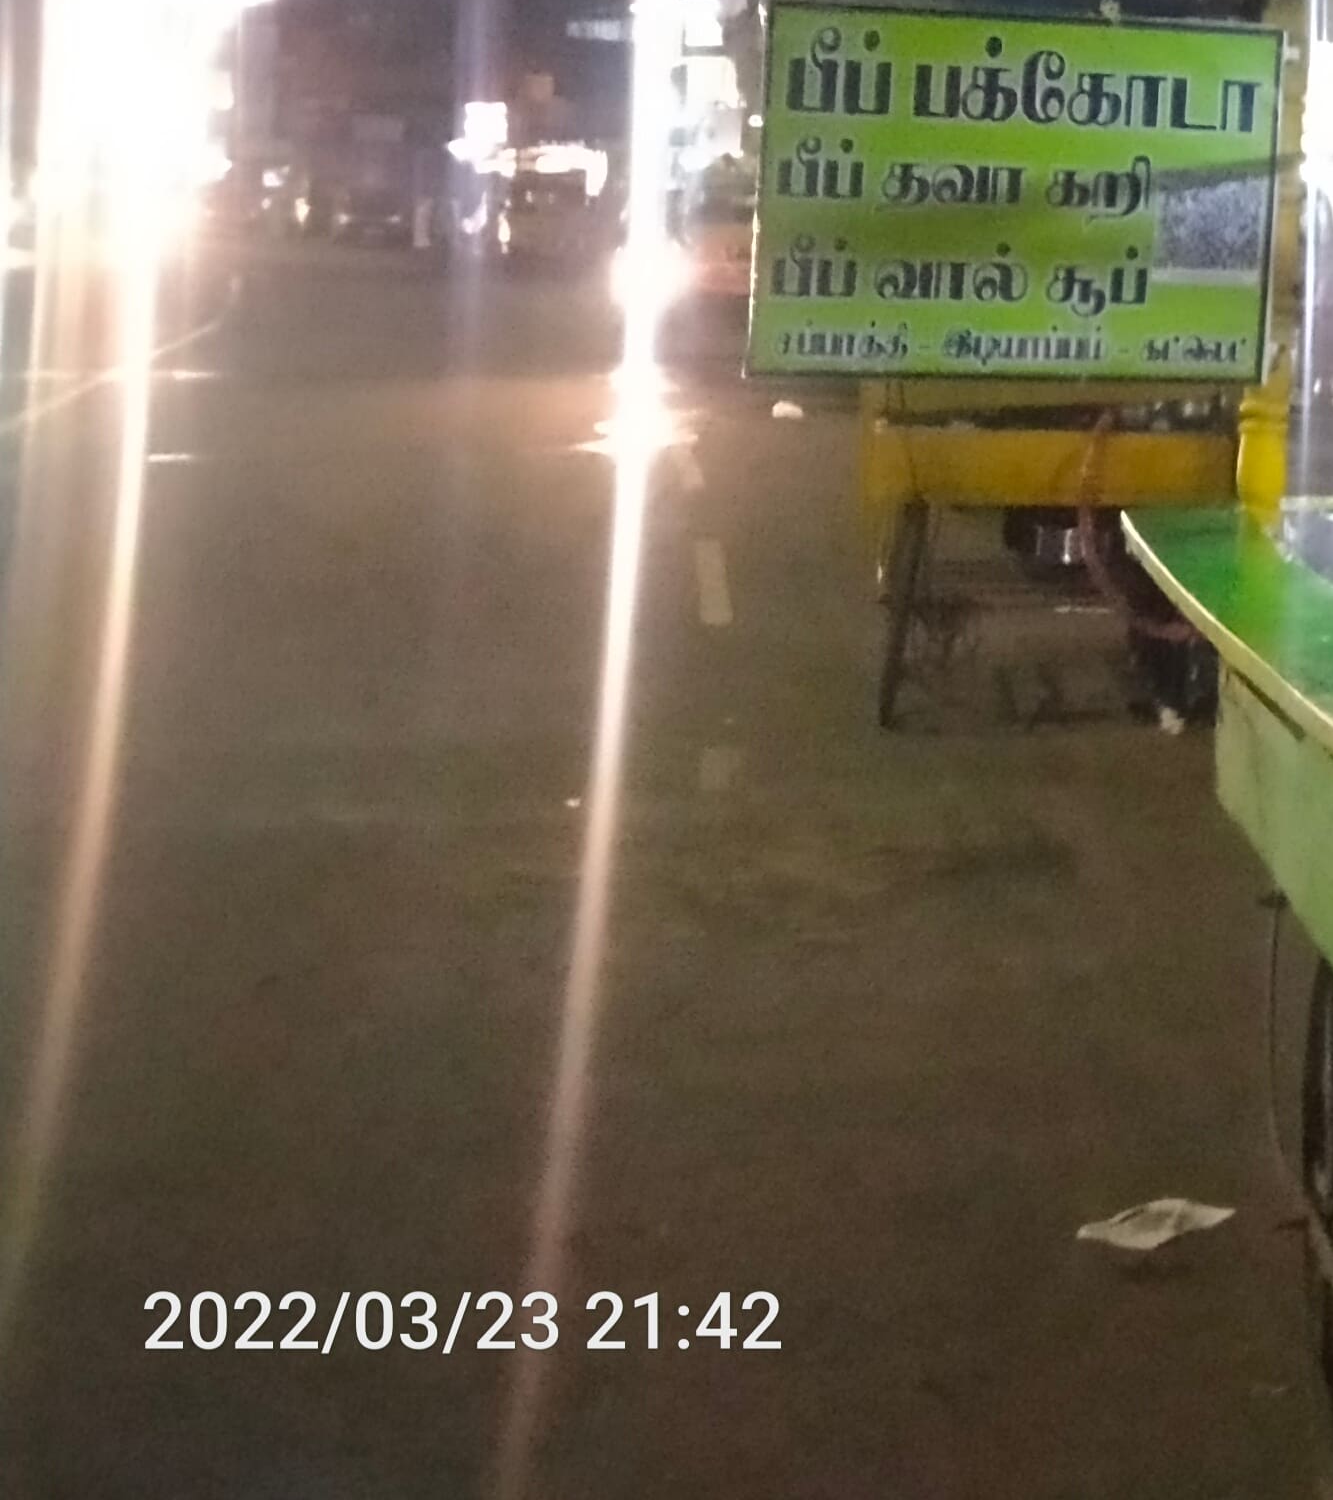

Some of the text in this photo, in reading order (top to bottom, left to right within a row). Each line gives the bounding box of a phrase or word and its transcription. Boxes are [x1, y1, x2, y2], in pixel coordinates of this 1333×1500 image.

[785, 26, 1262, 134] பீப் பக்கோடா
[776, 136, 1152, 218] பீப் தவா கறி
[770, 236, 1149, 318] பீப் வால் சூப்
